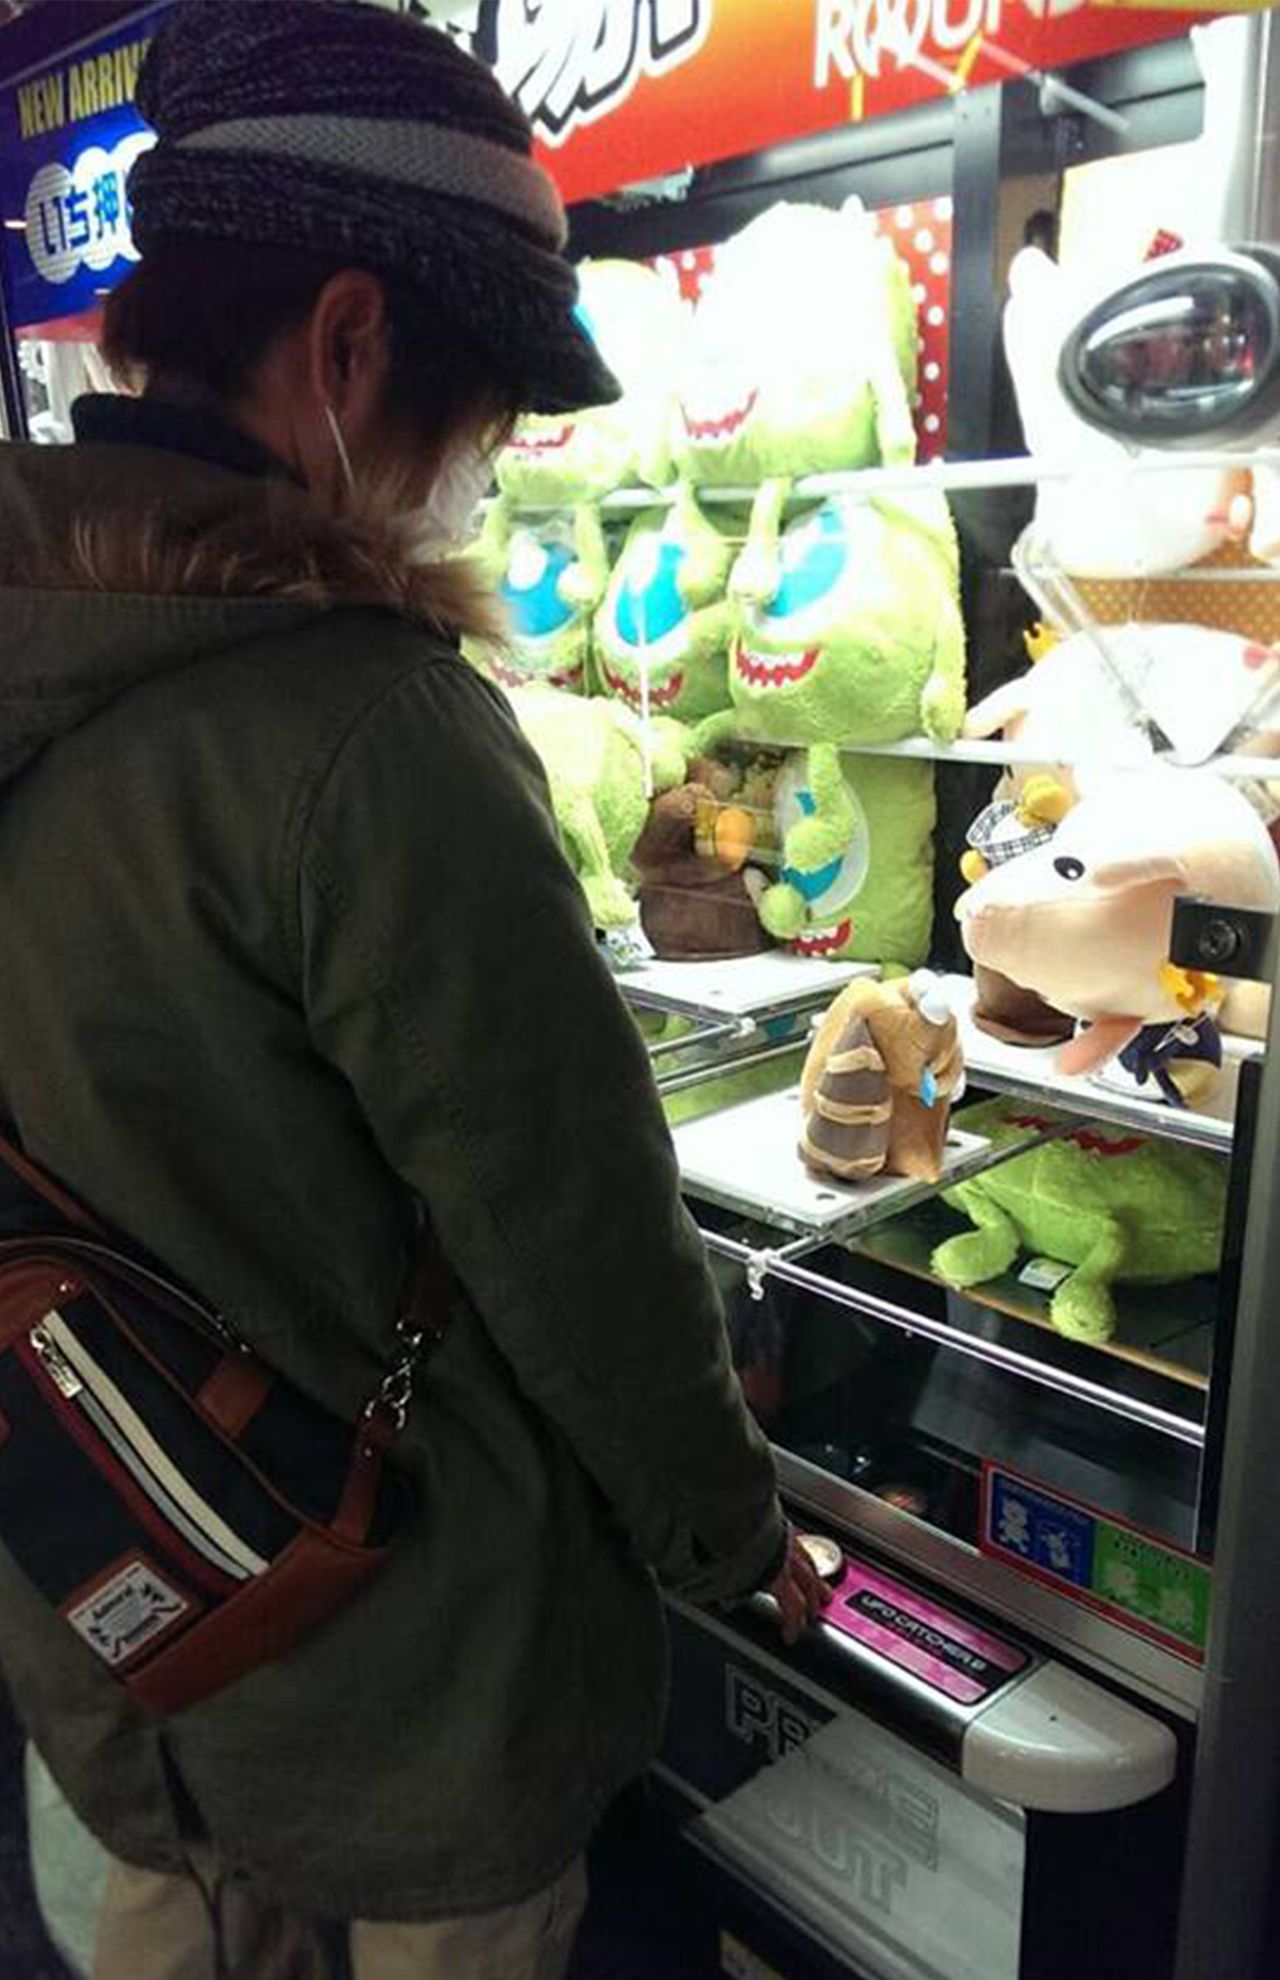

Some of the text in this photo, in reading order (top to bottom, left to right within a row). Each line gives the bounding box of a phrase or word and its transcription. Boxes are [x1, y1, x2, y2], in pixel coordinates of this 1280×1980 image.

[17, 38, 151, 140] NEW ARRIV
[861, 1596, 897, 1618] UFO
[894, 1613, 972, 1667] CATCHER
